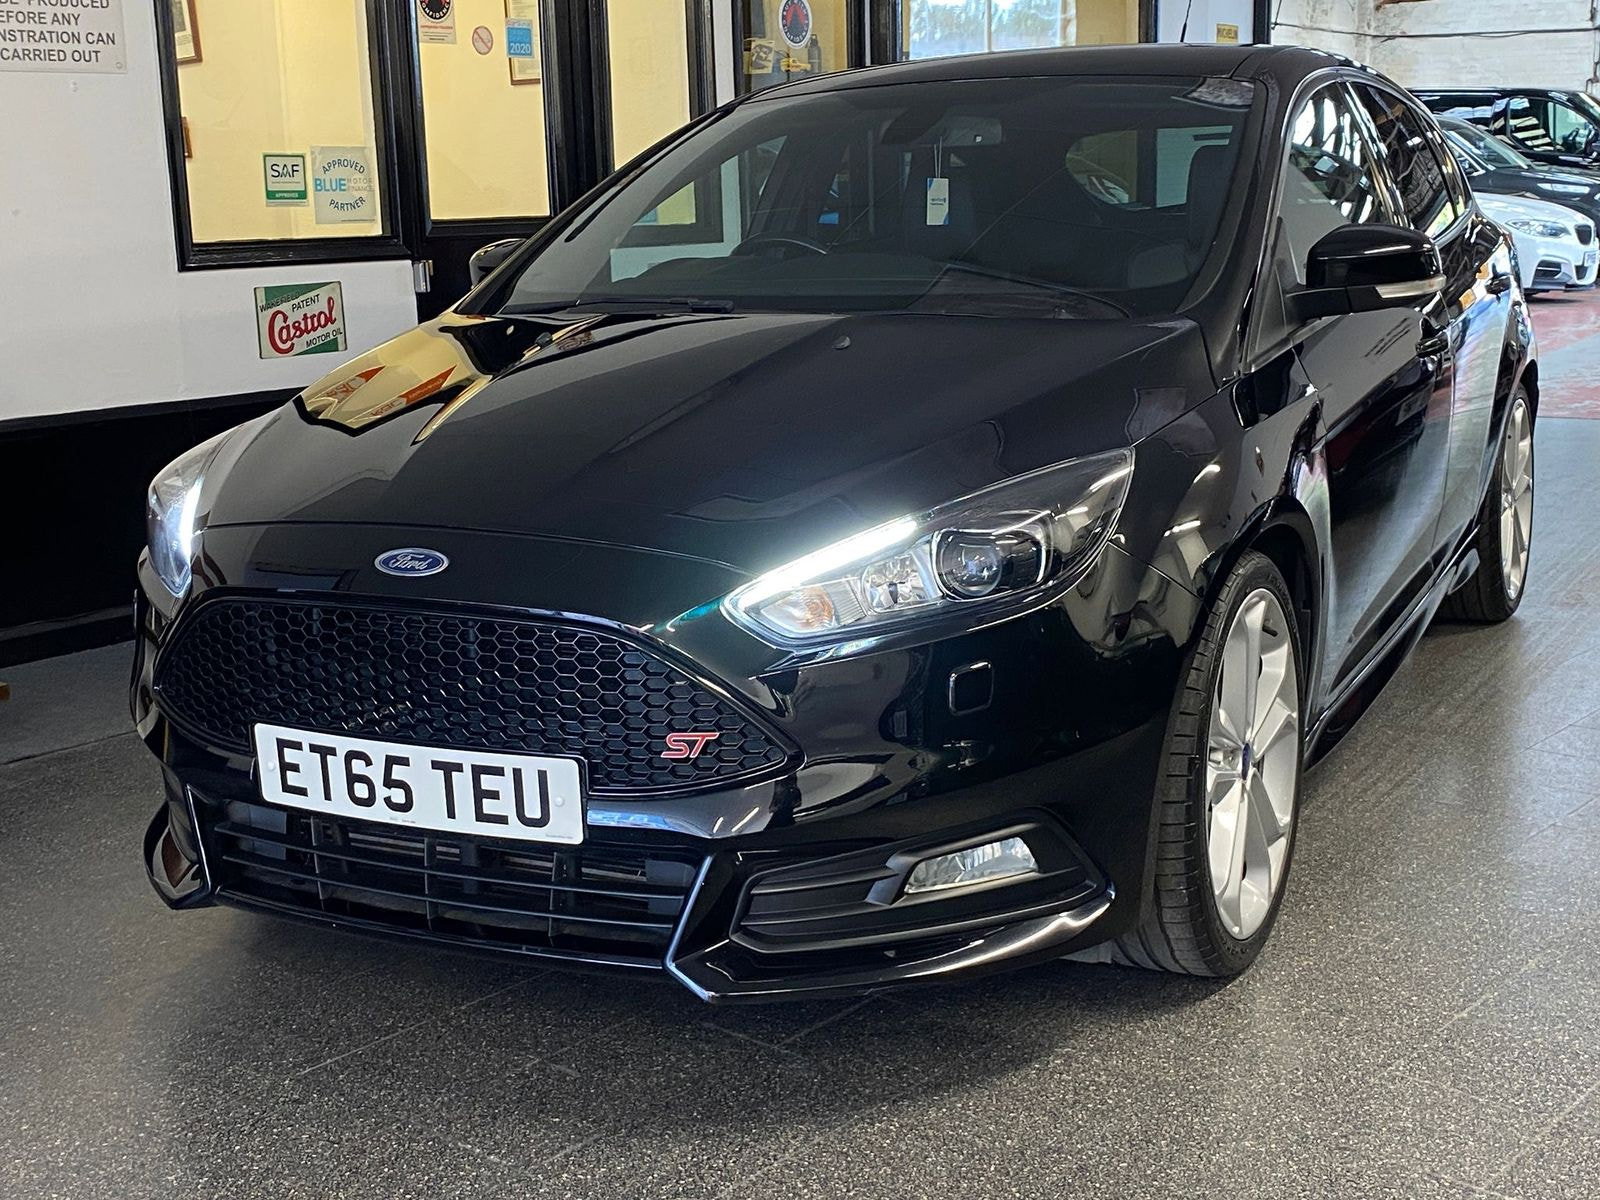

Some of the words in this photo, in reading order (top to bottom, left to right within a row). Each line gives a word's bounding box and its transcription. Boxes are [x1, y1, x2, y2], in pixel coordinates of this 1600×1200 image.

[51, 13, 81, 25] ANY
[85, 32, 116, 45] CAN
[0, 48, 67, 62] CARRIED
[71, 50, 101, 62] OUT
[510, 42, 531, 54] 2020
[270, 163, 300, 178] SAF
[322, 158, 366, 175] APPROVED
[314, 177, 347, 192] BLUE
[329, 196, 366, 211] PARTNER
[291, 293, 320, 312] PATENT
[268, 296, 337, 355] Castrol
[305, 331, 331, 348] MOTOR
[331, 328, 343, 338] OIL
[388, 552, 433, 570] Ford
[660, 732, 720, 759] ST
[276, 737, 415, 814] ET65
[430, 759, 551, 828] TEU
